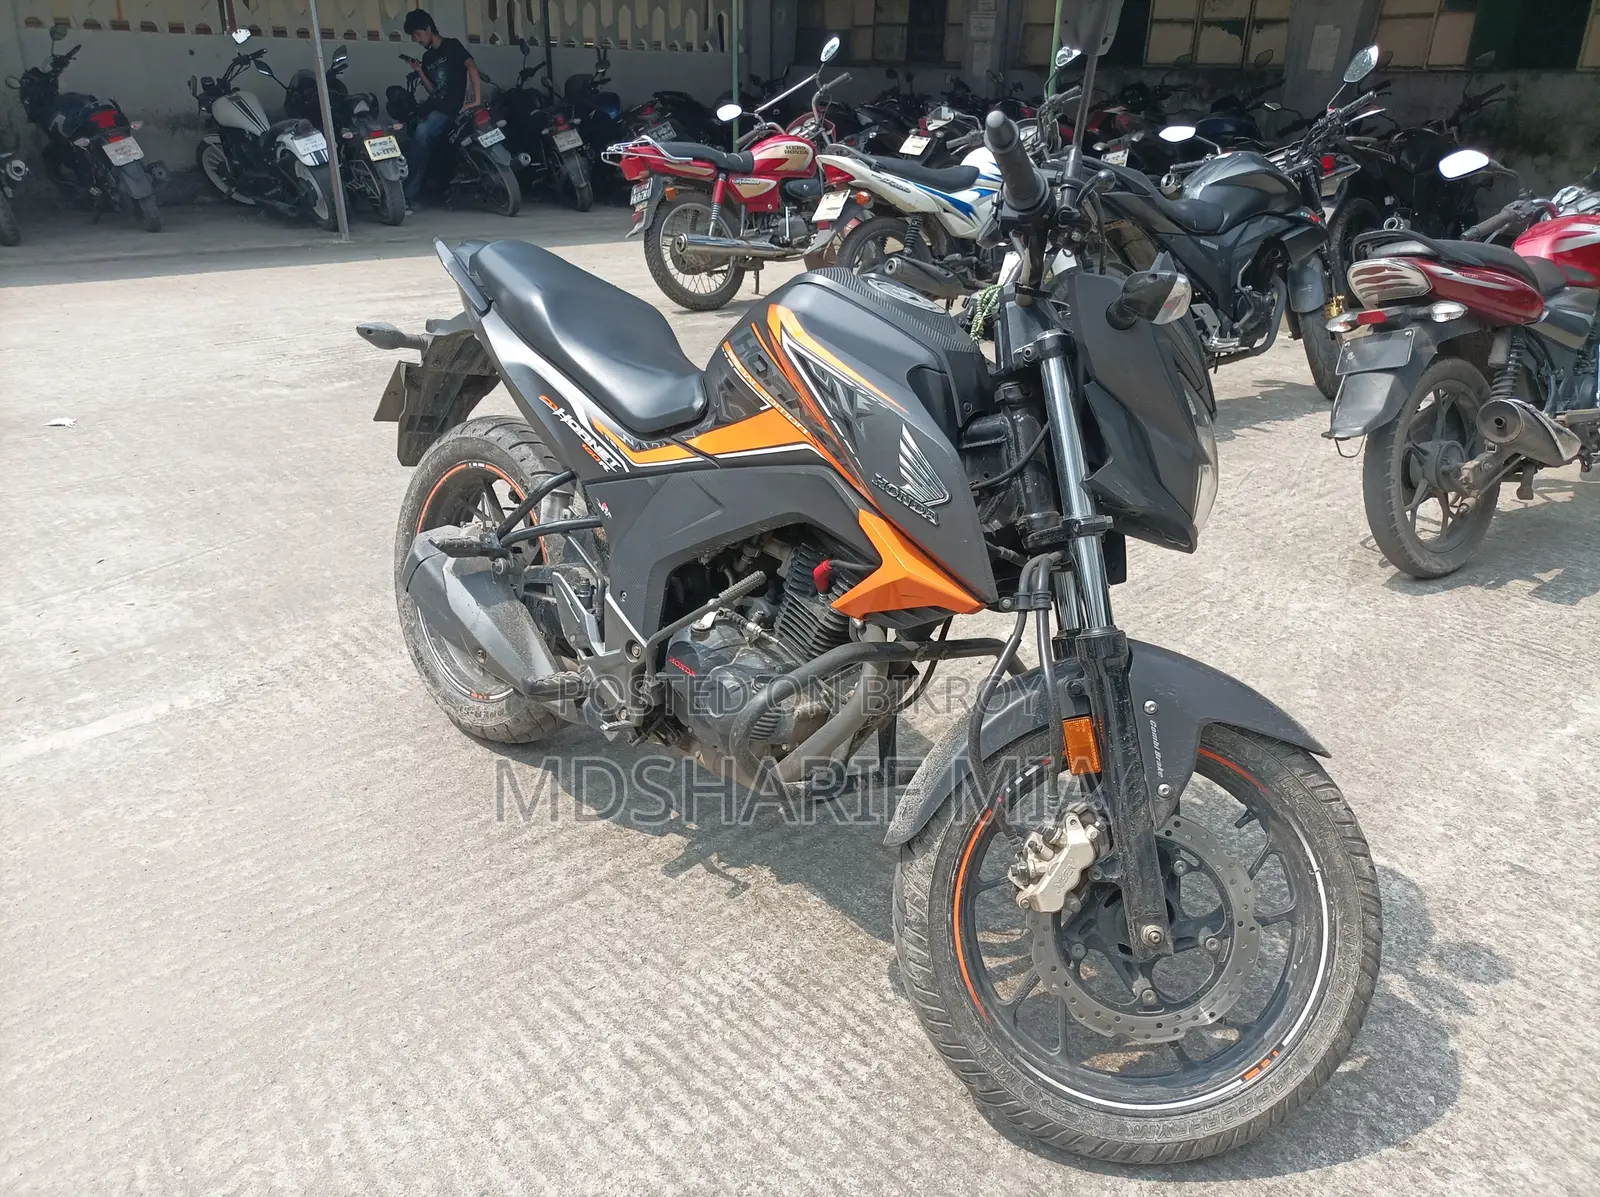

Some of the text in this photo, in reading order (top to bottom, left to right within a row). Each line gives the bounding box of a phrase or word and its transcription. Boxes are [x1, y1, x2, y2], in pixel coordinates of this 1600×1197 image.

[552, 407, 623, 473] HORNET
[871, 471, 941, 528] HONDA
[667, 655, 697, 679] HONDA
